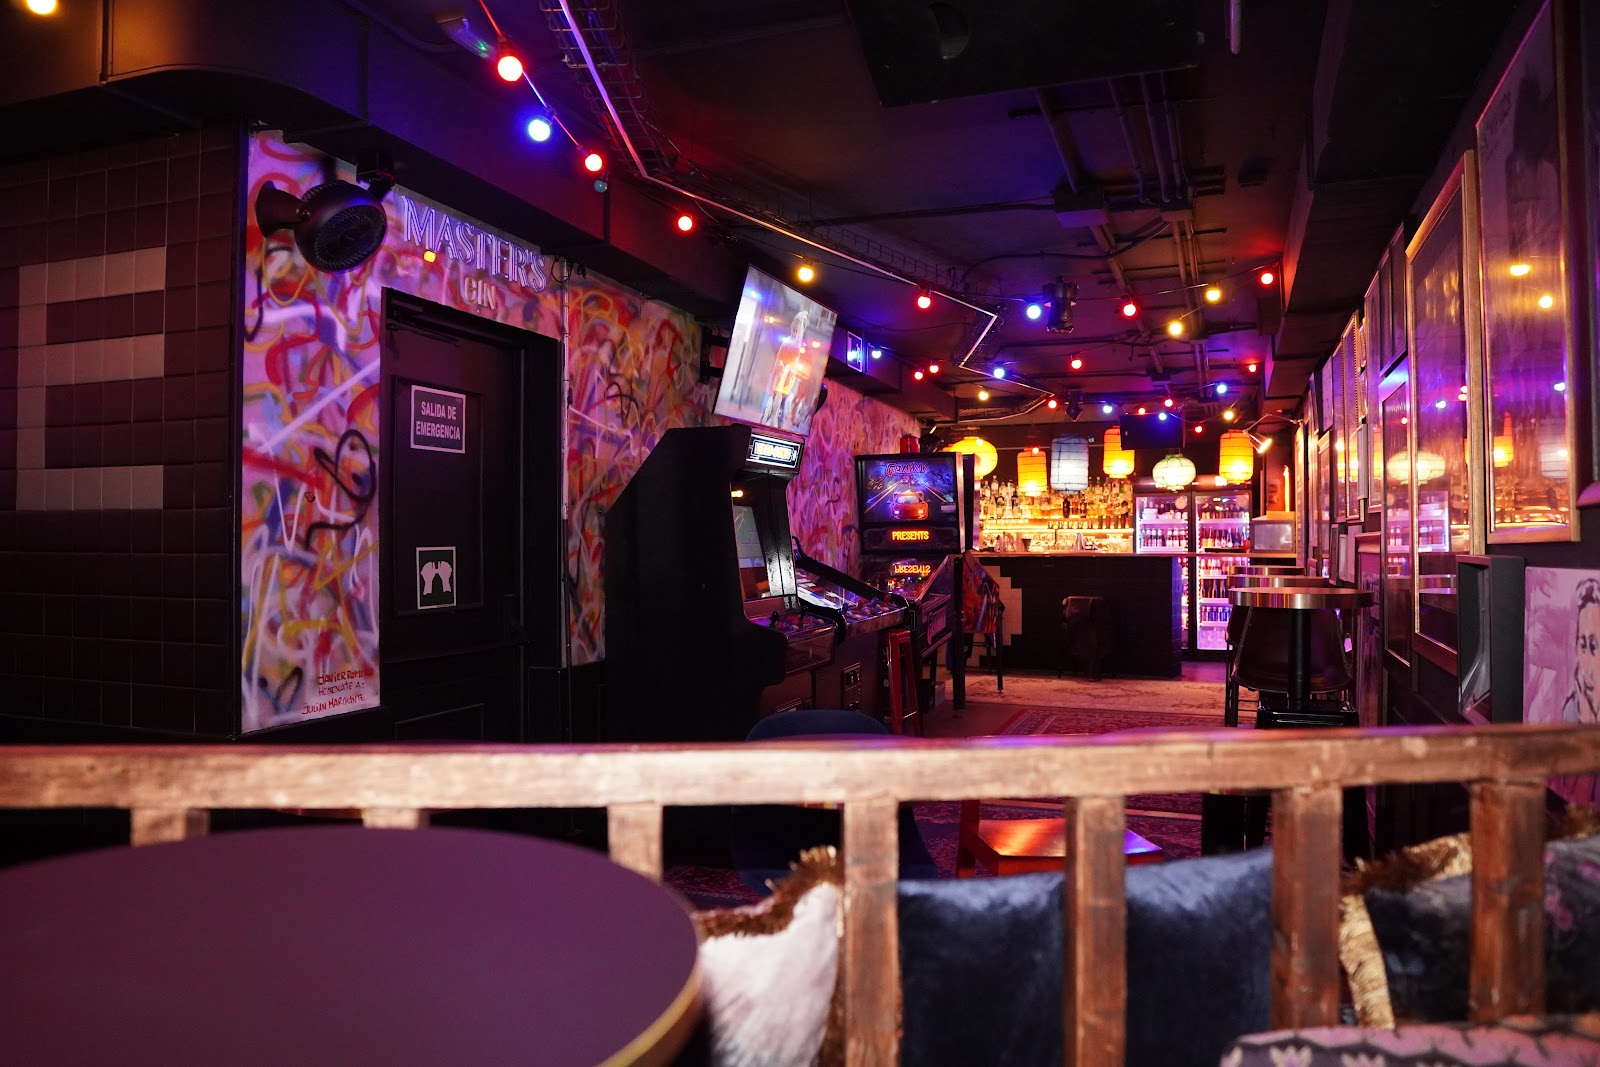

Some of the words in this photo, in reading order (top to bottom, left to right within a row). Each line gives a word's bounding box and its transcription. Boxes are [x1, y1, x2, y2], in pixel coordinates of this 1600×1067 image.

[464, 277, 496, 310] GIN
[421, 401, 446, 419] SALIDA
[447, 405, 457, 420] DE
[415, 420, 461, 440] EMERGENCIA
[892, 530, 929, 541] PRESENTS
